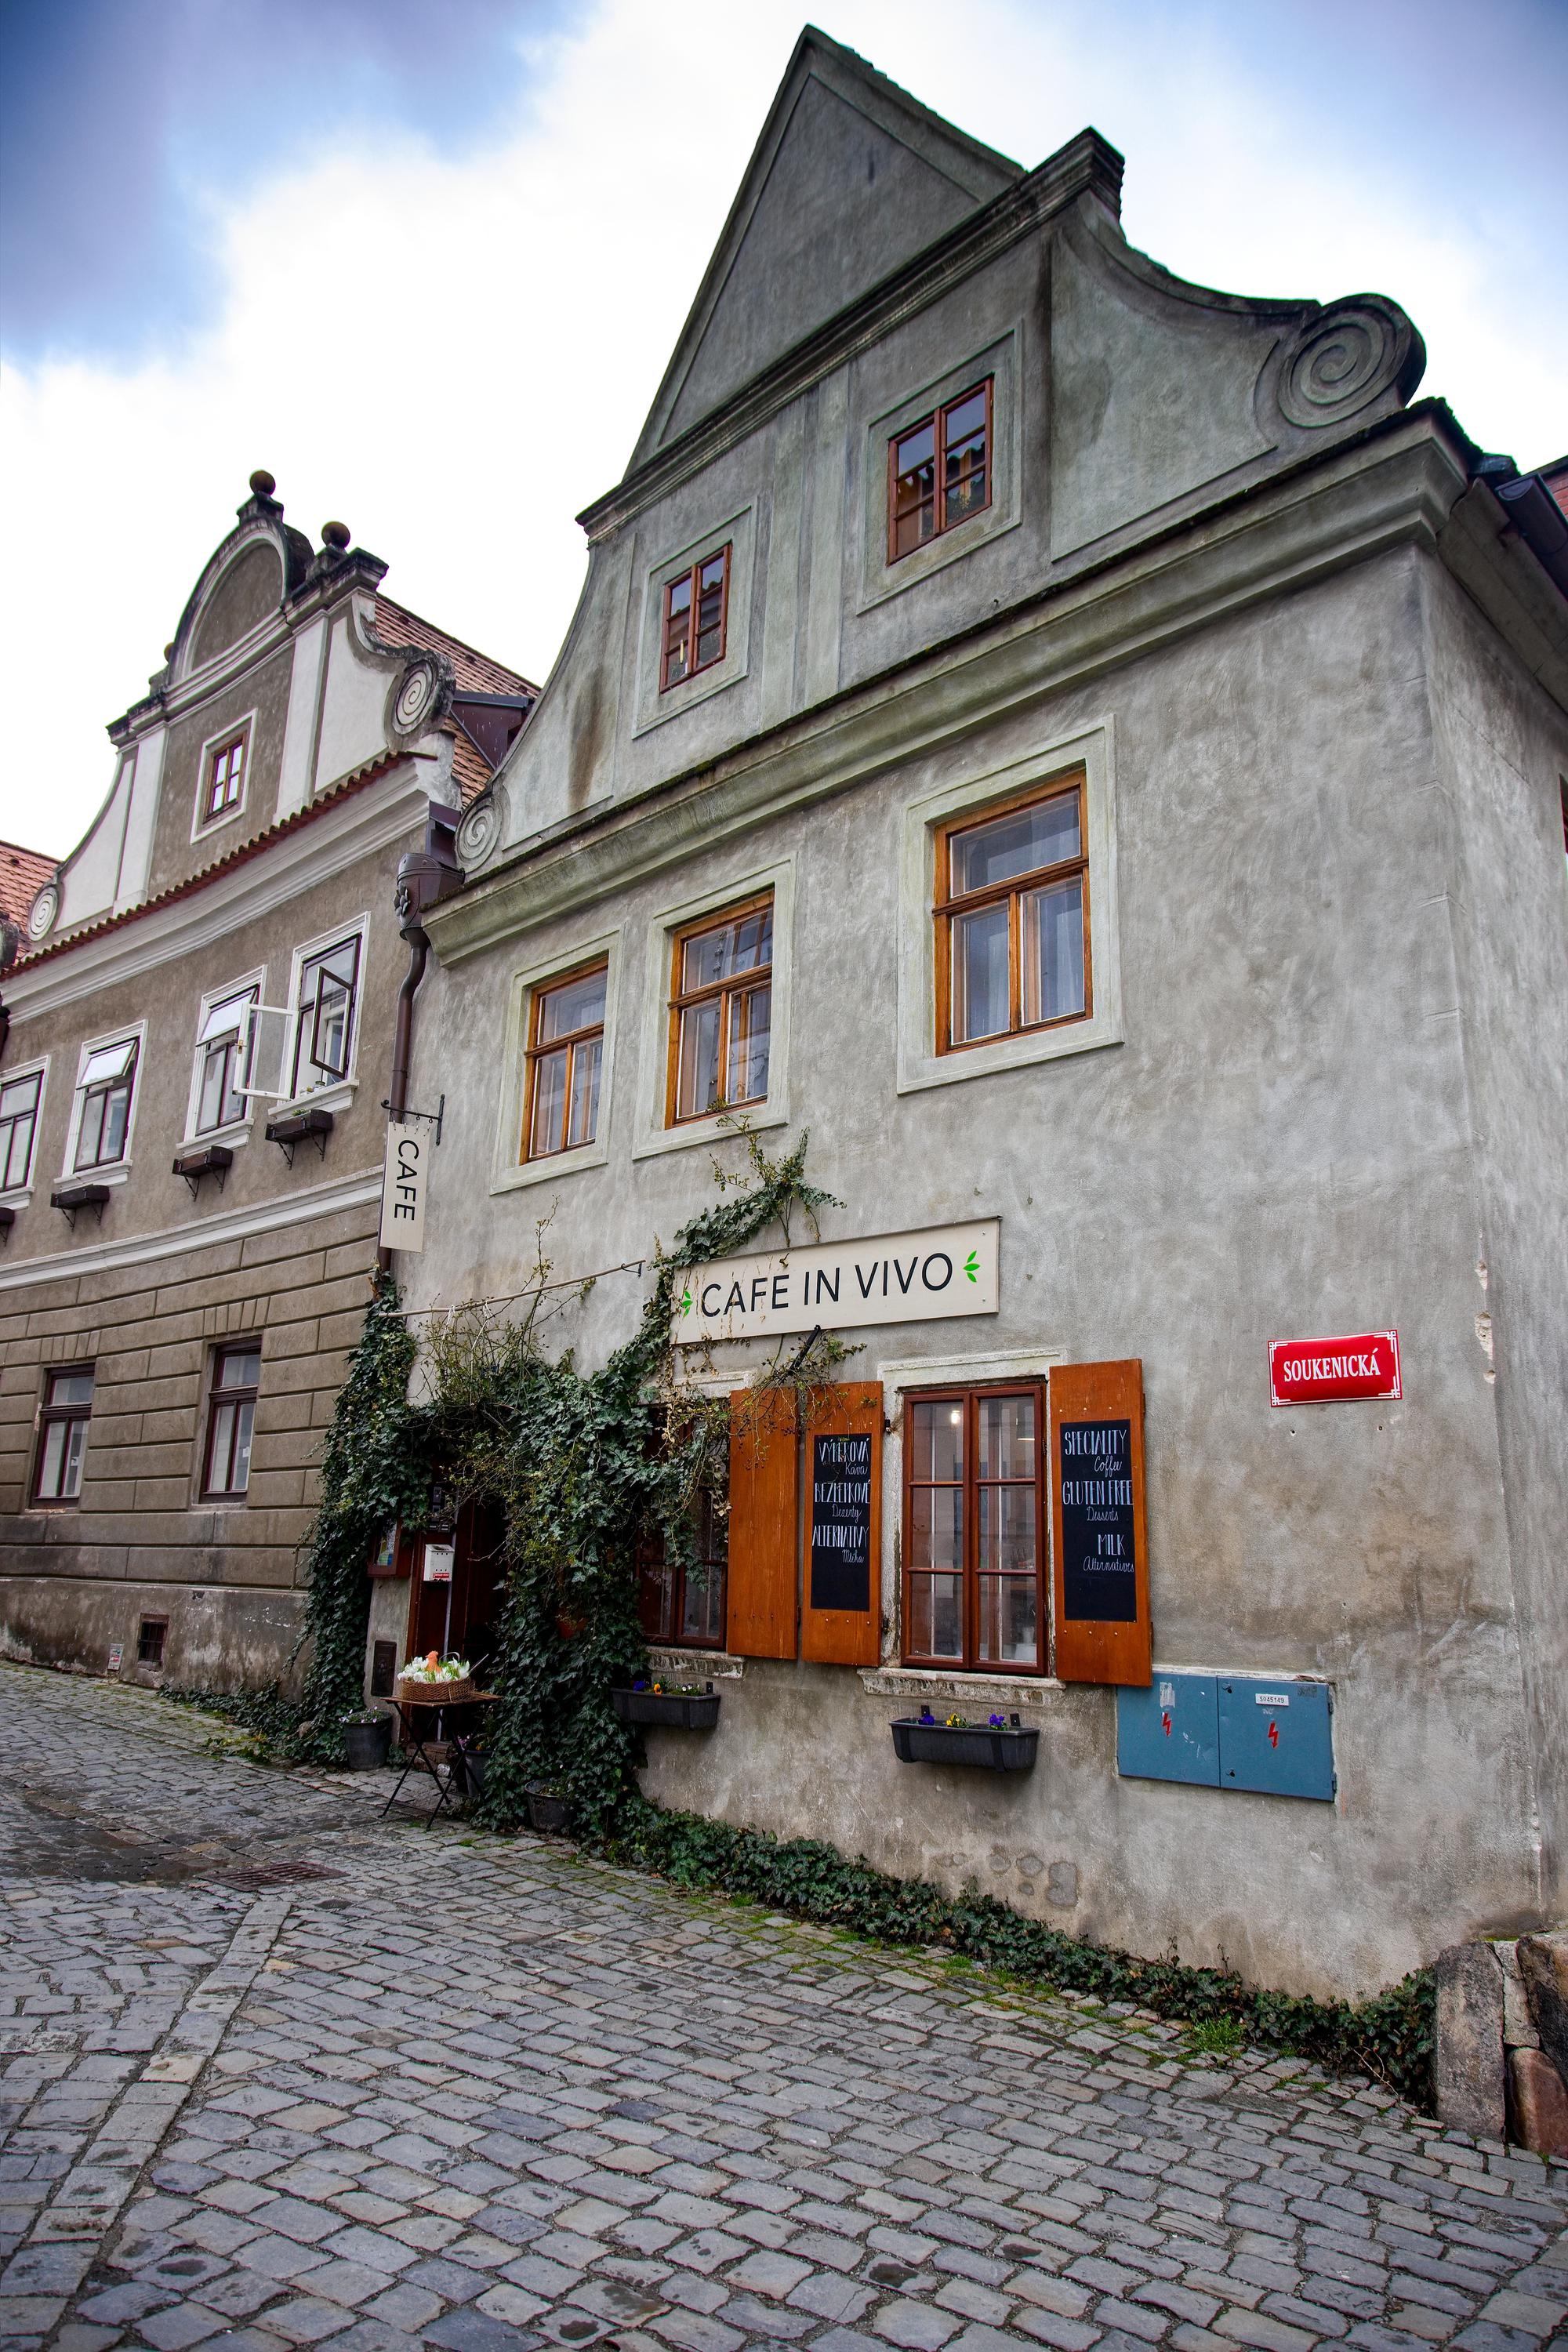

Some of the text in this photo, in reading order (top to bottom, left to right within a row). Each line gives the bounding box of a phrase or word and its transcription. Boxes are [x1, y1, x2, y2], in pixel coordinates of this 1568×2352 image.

[394, 1139, 419, 1221] CAFE
[700, 1252, 953, 1317] CAFE IN VIVO
[1283, 1347, 1381, 1382] SOUKENICKÁ
[1065, 1429, 1127, 1455] SPECIALITY
[845, 1461, 868, 1475] Káva
[1094, 1455, 1122, 1478] Coffee
[815, 1479, 871, 1504] BEZLEPKOVÉ
[1062, 1479, 1134, 1505] GLUTEN FREE
[832, 1504, 862, 1523] Dezerty
[1087, 1505, 1119, 1521] Desserts
[812, 1525, 869, 1548] ALTERNATIVY
[1098, 1534, 1126, 1555] MILK
[1083, 1555, 1134, 1573] Alternatives
